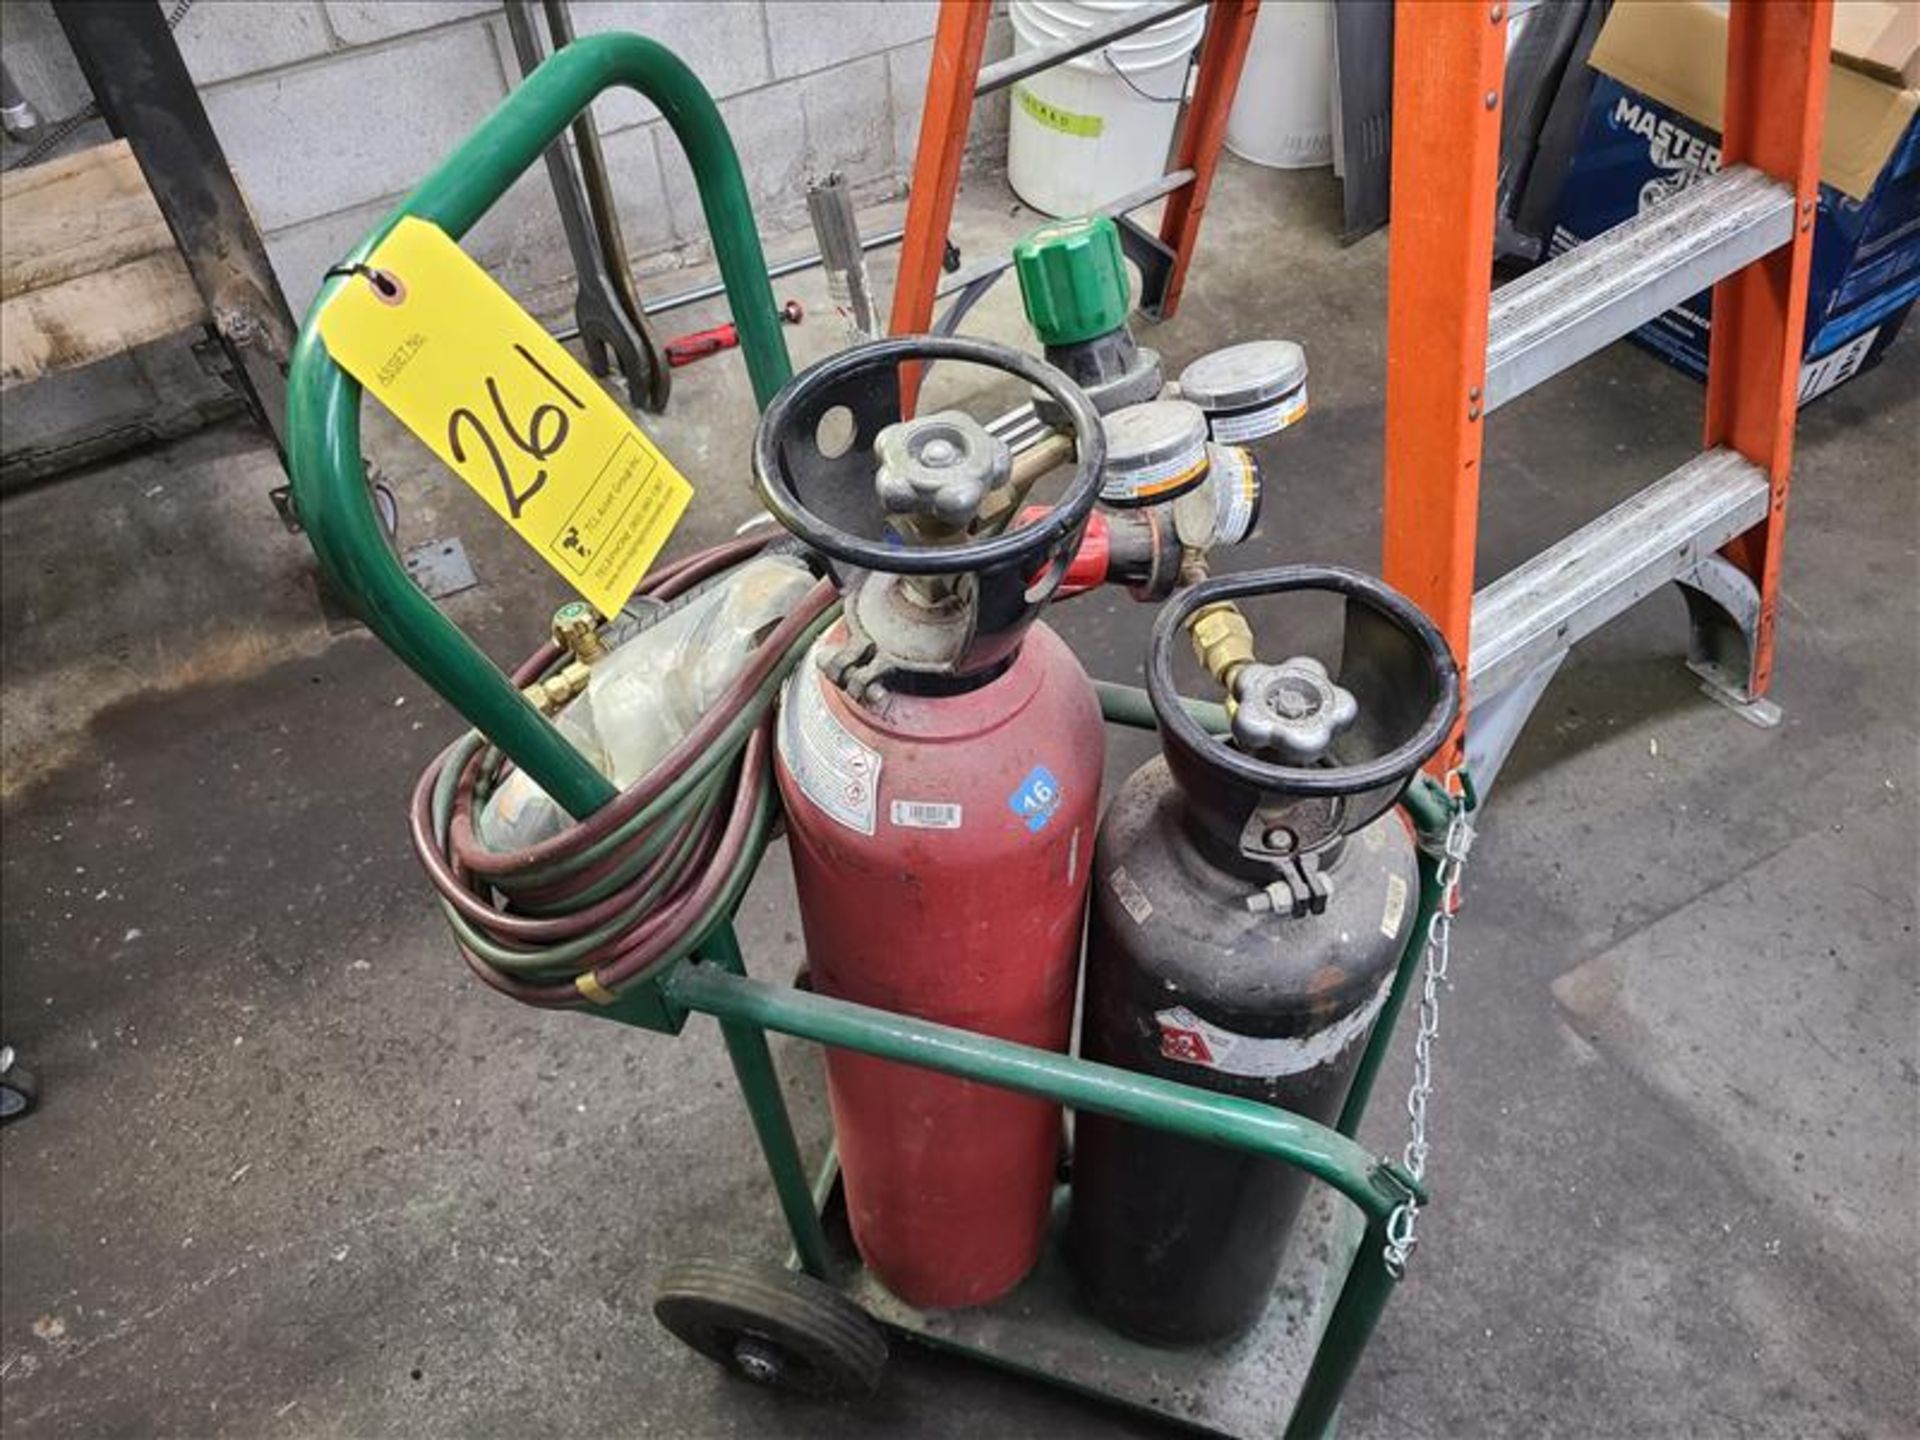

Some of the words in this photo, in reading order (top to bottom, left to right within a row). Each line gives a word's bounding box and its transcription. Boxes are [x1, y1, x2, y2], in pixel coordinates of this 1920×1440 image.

[1614, 97, 1722, 175] MASTER
[448, 343, 586, 519] 261
[1024, 780, 1052, 807] 16
